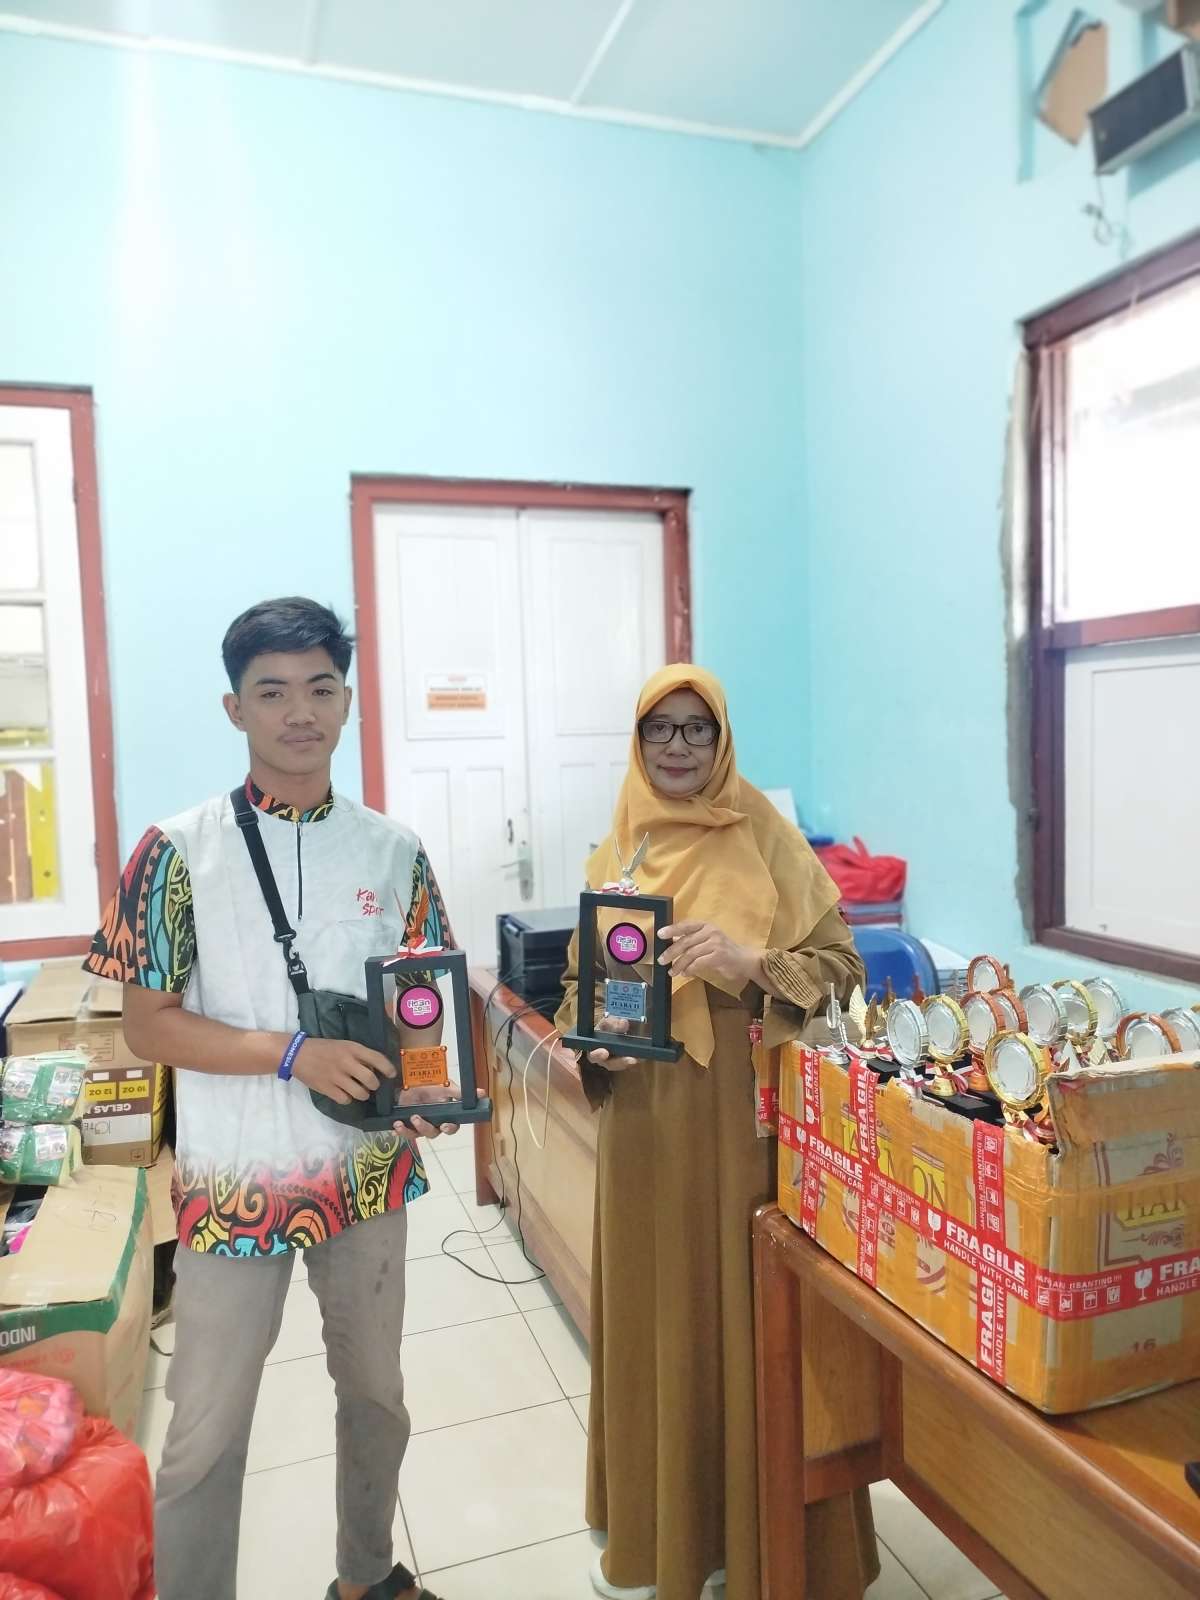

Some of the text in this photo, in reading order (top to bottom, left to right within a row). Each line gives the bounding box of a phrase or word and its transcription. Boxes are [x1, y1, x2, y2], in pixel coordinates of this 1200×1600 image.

[94, 1103, 132, 1114] GELAS
[867, 1087, 876, 1113] WITH
[809, 1135, 863, 1179] FRAGILE
[867, 1116, 877, 1160] HANDLE
[807, 1150, 865, 1193] HANDLE WITH CARE
[943, 1240, 1030, 1300] HANDLE WITH CARE
[946, 1221, 1026, 1282] FRAGILE
[1156, 1278, 1199, 1297] HANDLE
[993, 1286, 1006, 1377] HANDLE WITH
